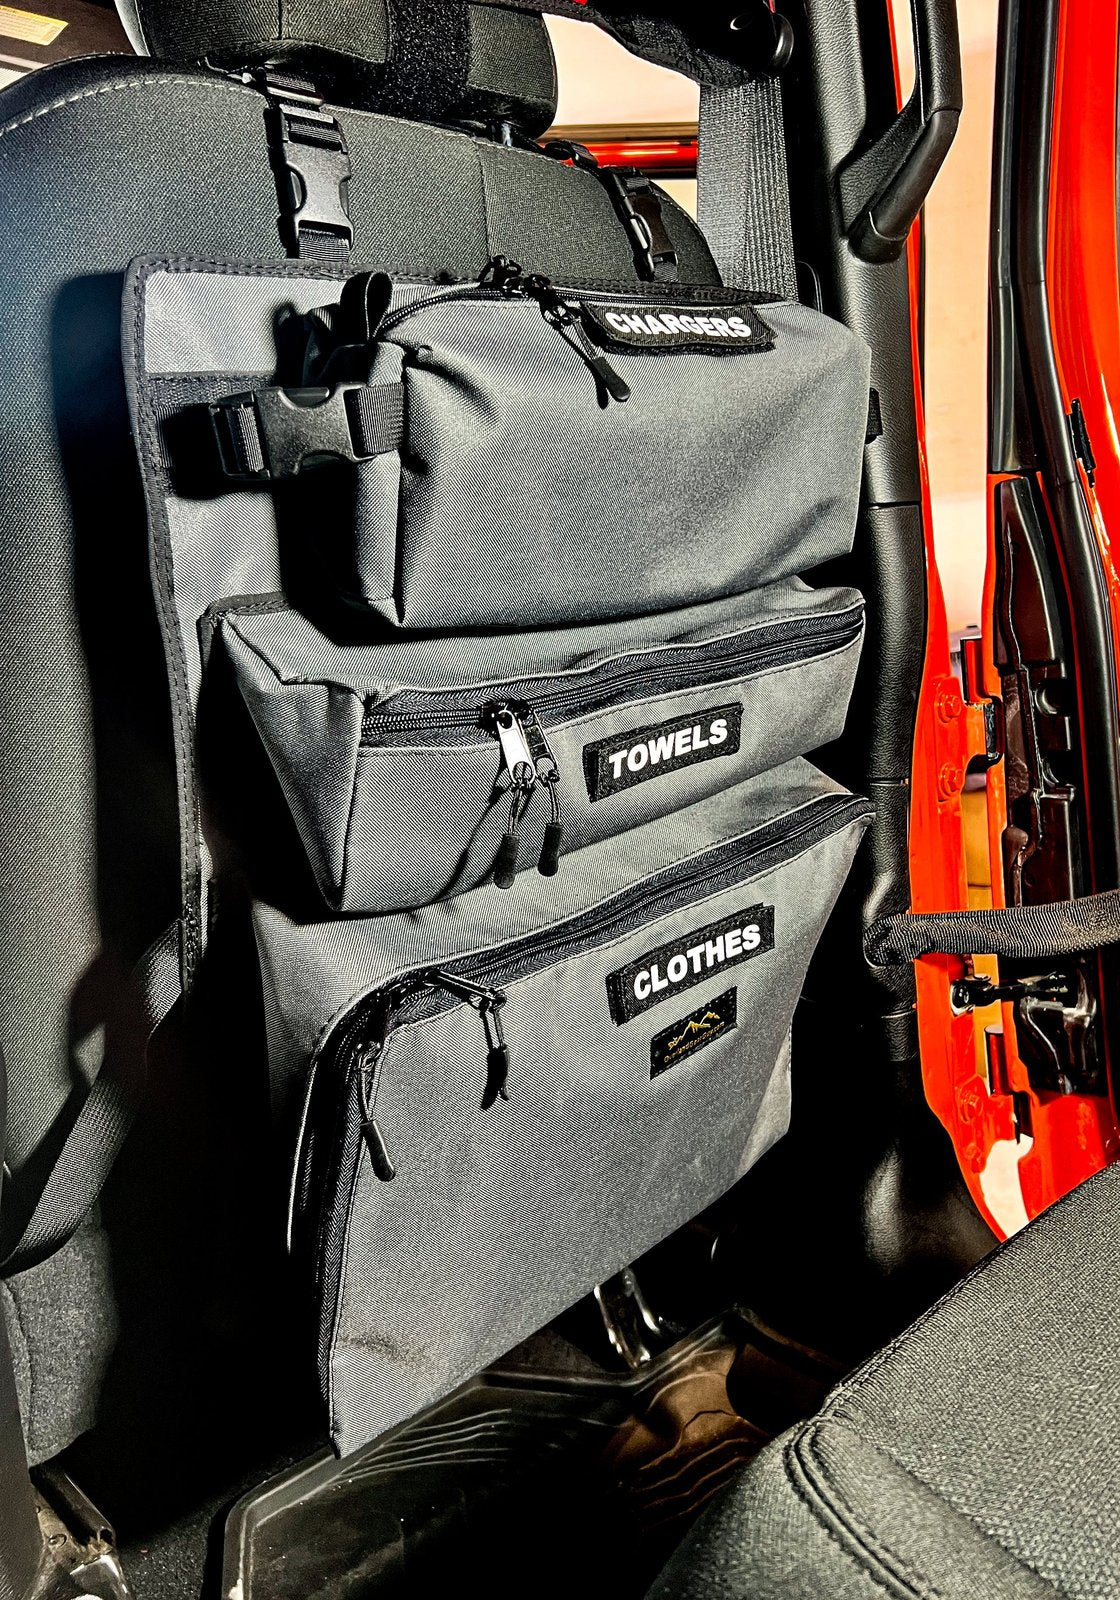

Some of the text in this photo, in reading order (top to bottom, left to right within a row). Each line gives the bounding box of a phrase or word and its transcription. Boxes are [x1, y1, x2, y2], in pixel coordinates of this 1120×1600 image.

[604, 312, 752, 338] CHARGERS
[608, 718, 728, 780] TOWELS
[633, 924, 761, 1000] CLOTHES
